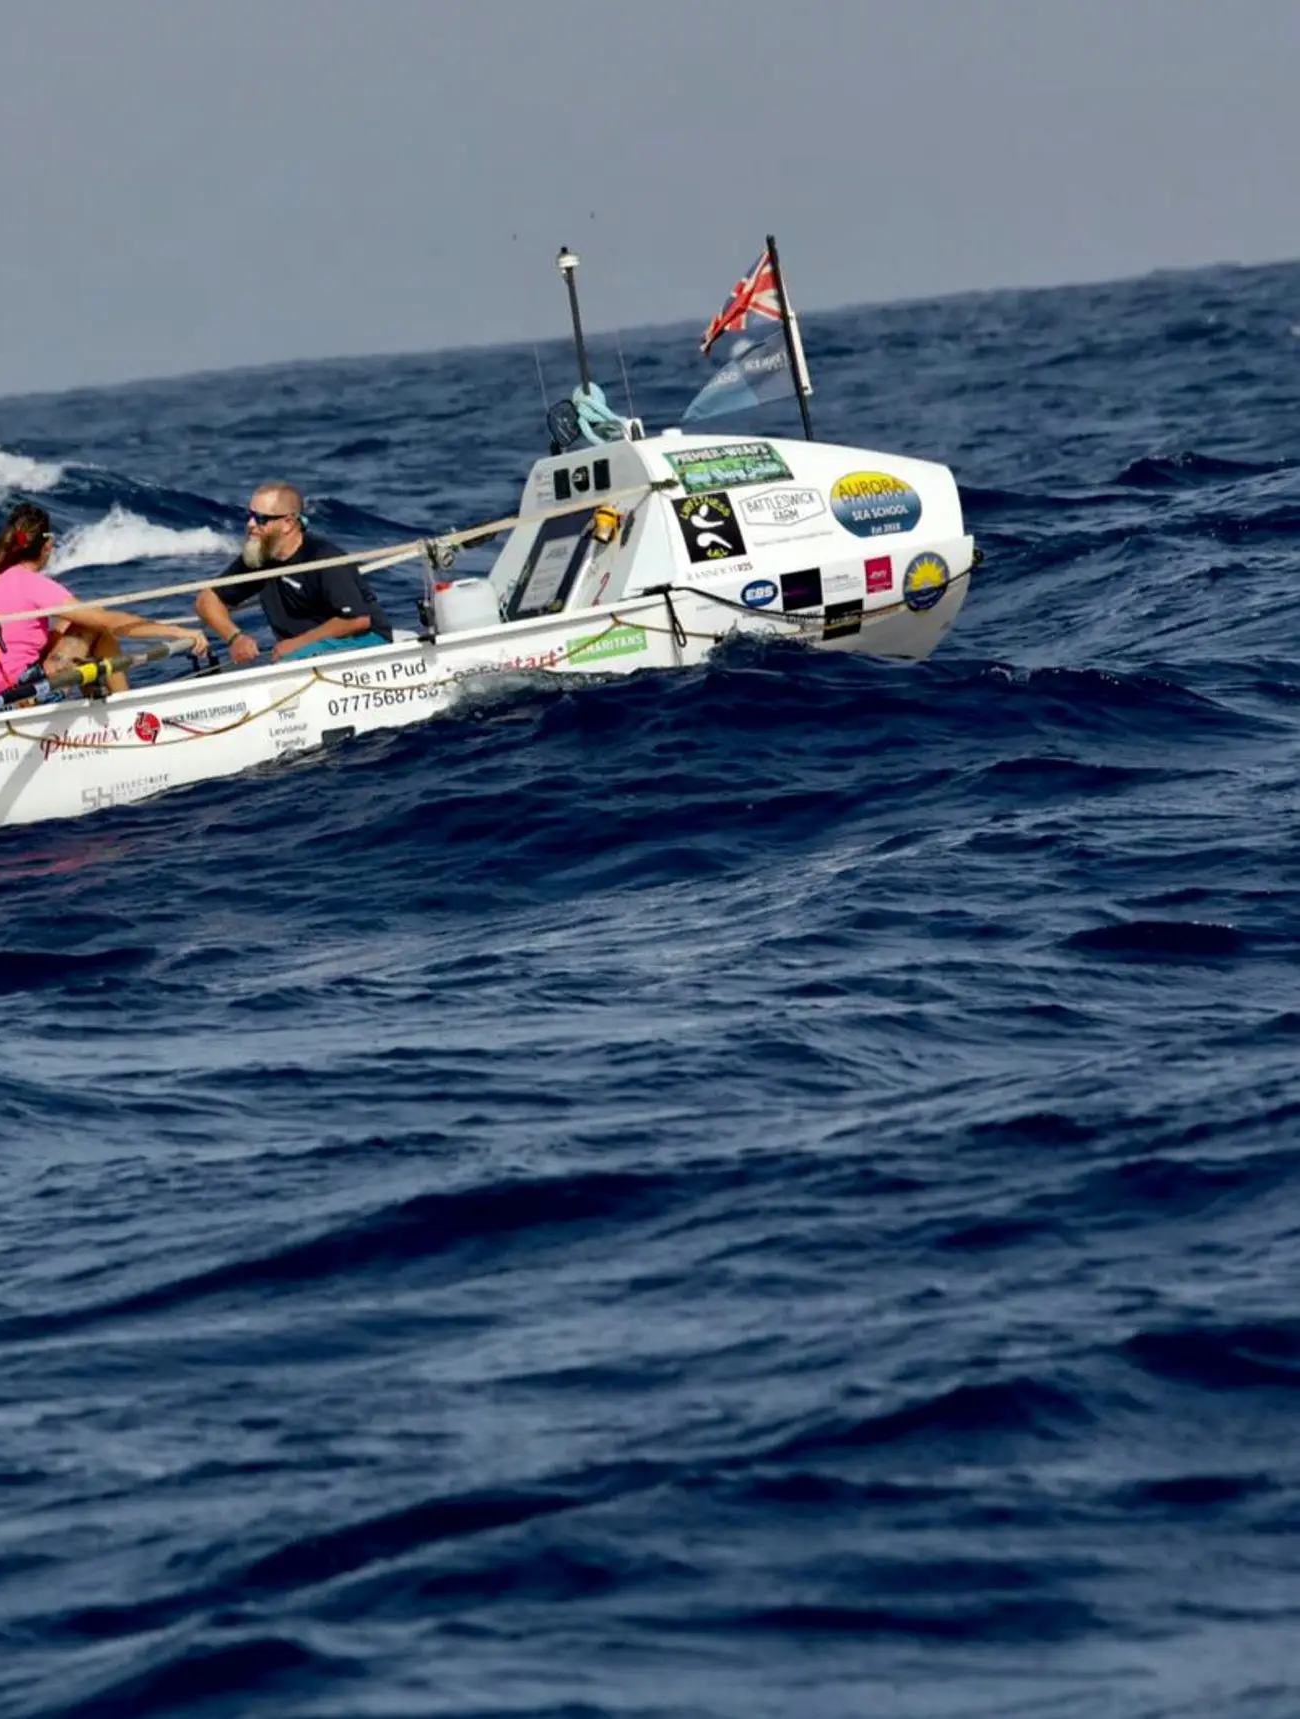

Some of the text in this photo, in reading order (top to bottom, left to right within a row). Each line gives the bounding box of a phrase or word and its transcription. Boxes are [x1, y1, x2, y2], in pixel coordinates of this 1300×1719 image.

[838, 479, 904, 497] AURORA
[852, 504, 909, 521] SEA SCHOOL
[342, 659, 426, 687] Pie n Pud
[277, 710, 296, 721] The
